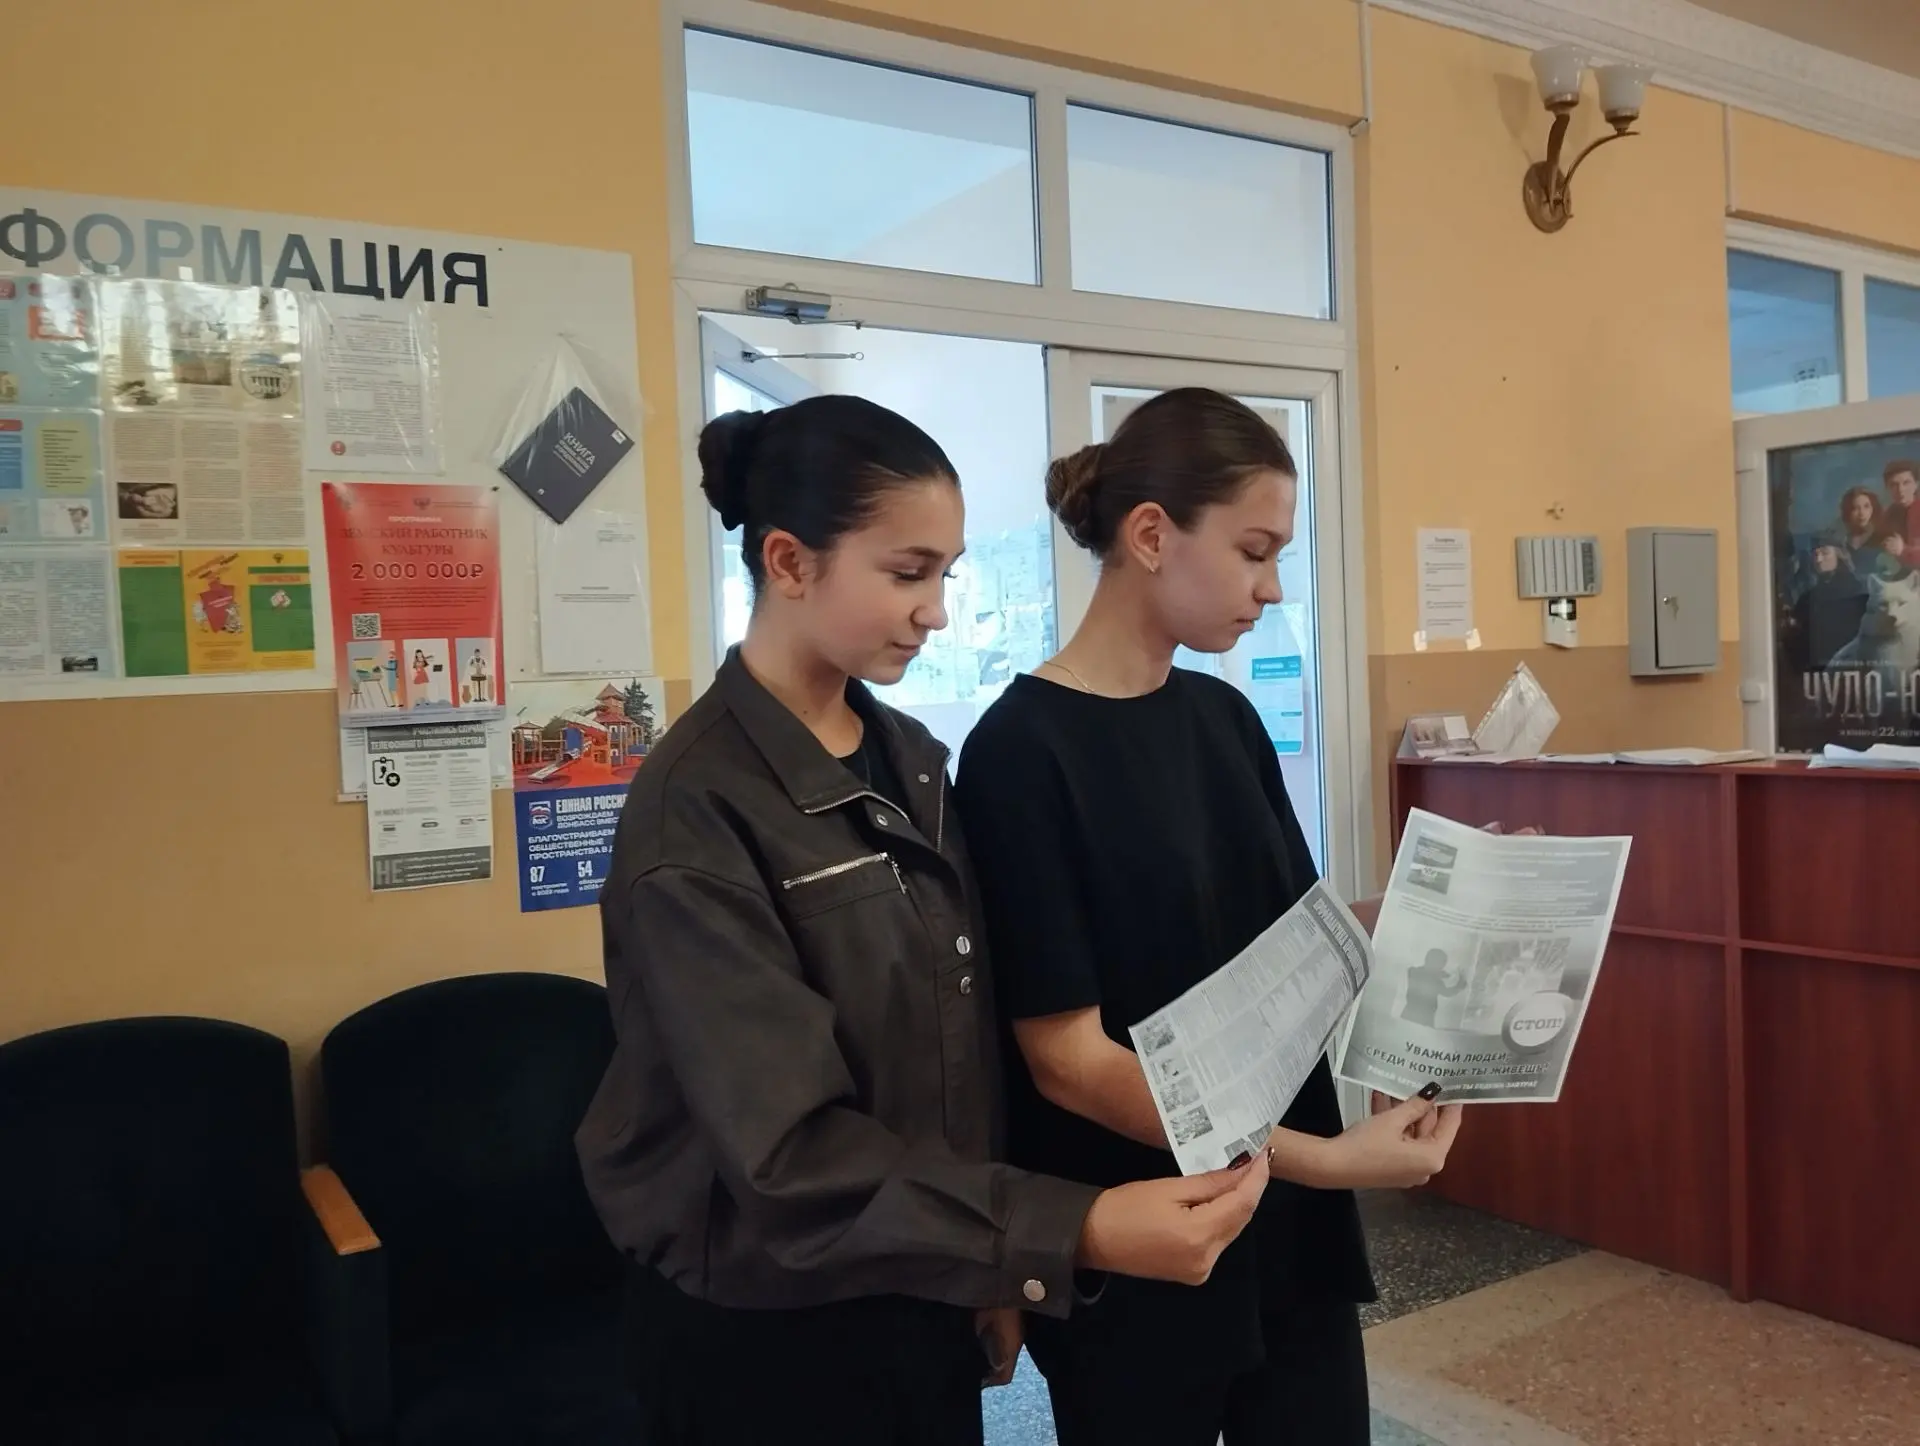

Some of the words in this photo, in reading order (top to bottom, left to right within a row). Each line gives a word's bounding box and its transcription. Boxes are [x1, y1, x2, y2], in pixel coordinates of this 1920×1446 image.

[0, 206, 489, 309] ФОРМАЦИЯ
[562, 432, 596, 466] КНИГА
[414, 528, 488, 540] РАБОТНИК
[381, 543, 454, 555] КУЛЬТУРЫ
[351, 562, 366, 579] 2
[373, 562, 418, 579] 000
[1879, 726, 1895, 738] 22
[556, 796, 592, 814] ЕДИНАЯ
[557, 810, 614, 822] ВОЗРОЖДАЕМ
[557, 820, 596, 829] ДОНБАСС
[528, 828, 616, 844] БЛАГОУСТРАИВАЕМ
[529, 837, 604, 852] ОБЩЕСТВЕННЫЕ
[529, 847, 599, 861] ПРОСТРАНСТВА
[375, 859, 404, 886] НЕ
[529, 865, 546, 883] 87
[577, 860, 593, 878] 54
[1512, 1017, 1563, 1031] СТОП!
[1405, 1041, 1460, 1064] УВАЖАЙ
[1365, 1046, 1406, 1067] СРЕДИ
[1409, 1060, 1468, 1077] КОТОРЫХ
[1470, 1067, 1487, 1077] ТЫ
